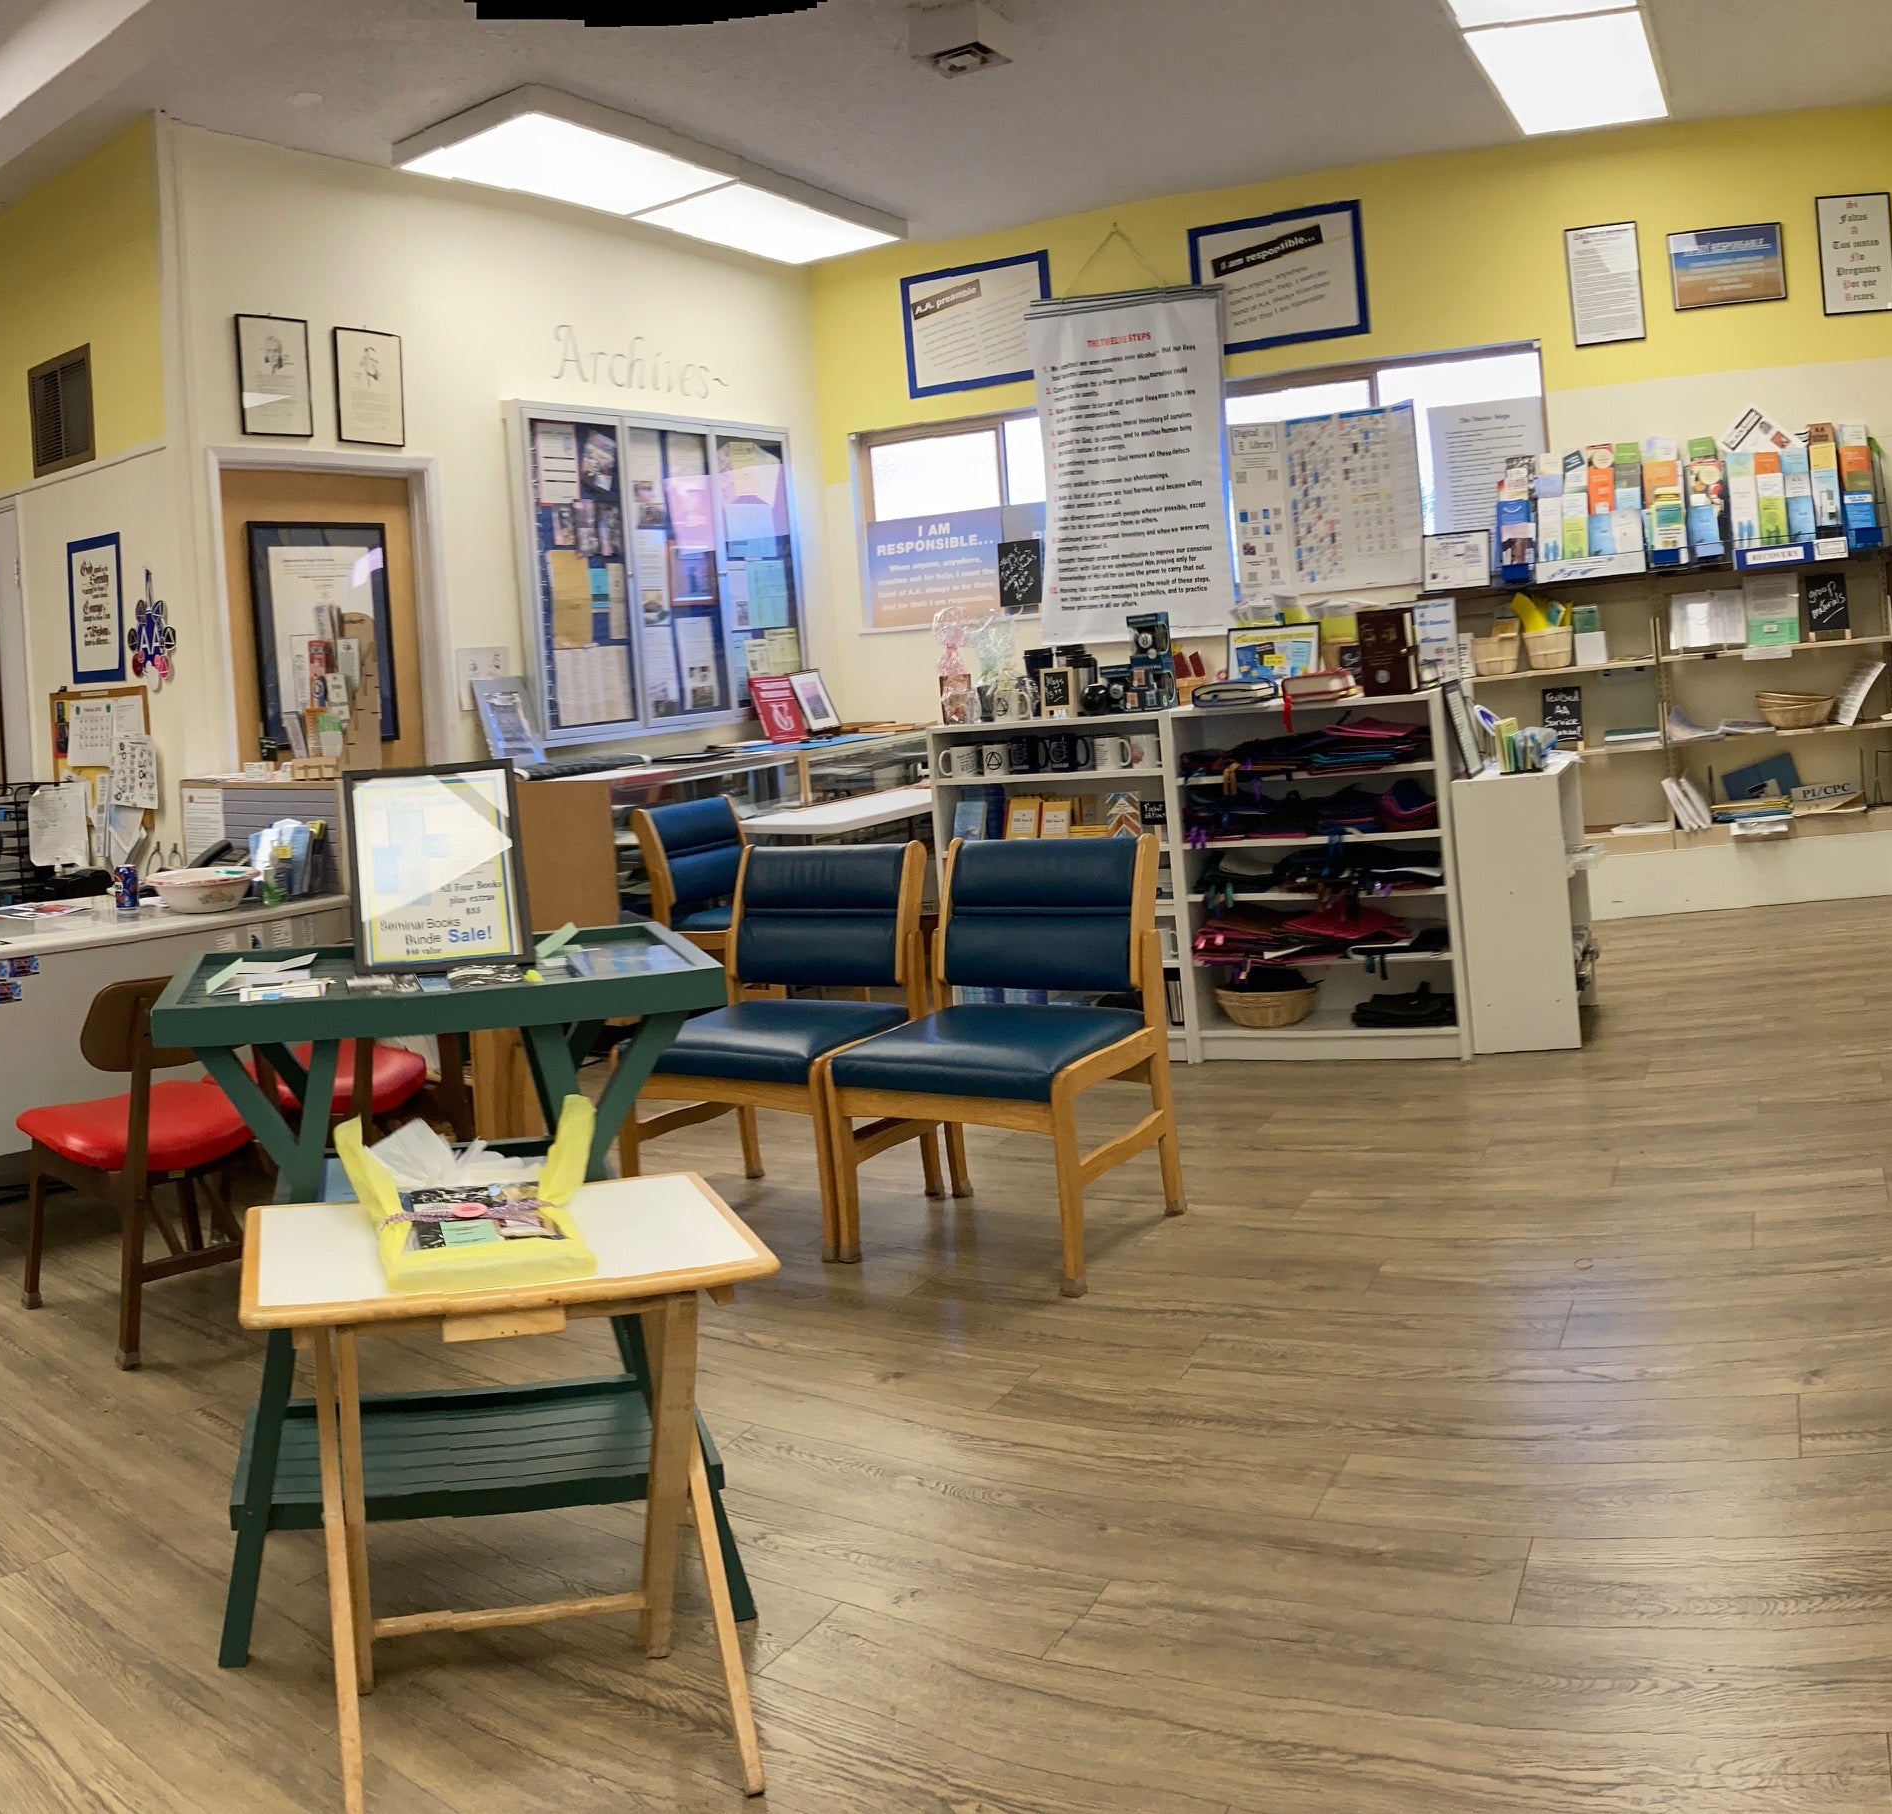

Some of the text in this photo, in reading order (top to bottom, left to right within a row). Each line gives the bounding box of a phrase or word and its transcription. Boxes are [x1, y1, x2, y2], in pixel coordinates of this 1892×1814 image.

[1220, 236, 1315, 271] I am responsible...
[913, 286, 978, 316] A.A. preamble
[553, 323, 712, 400] Archives
[1234, 429, 1259, 439] Digital
[1249, 439, 1275, 450] Library
[918, 523, 950, 537] I AM
[877, 534, 993, 556] RESPONSIBLE...
[1752, 549, 1798, 560] RECOVERY
[1809, 581, 1836, 603] group
[1802, 782, 1850, 799] PI/CPC
[380, 918, 461, 931] Seminar Books
[449, 926, 492, 943] Sale!
